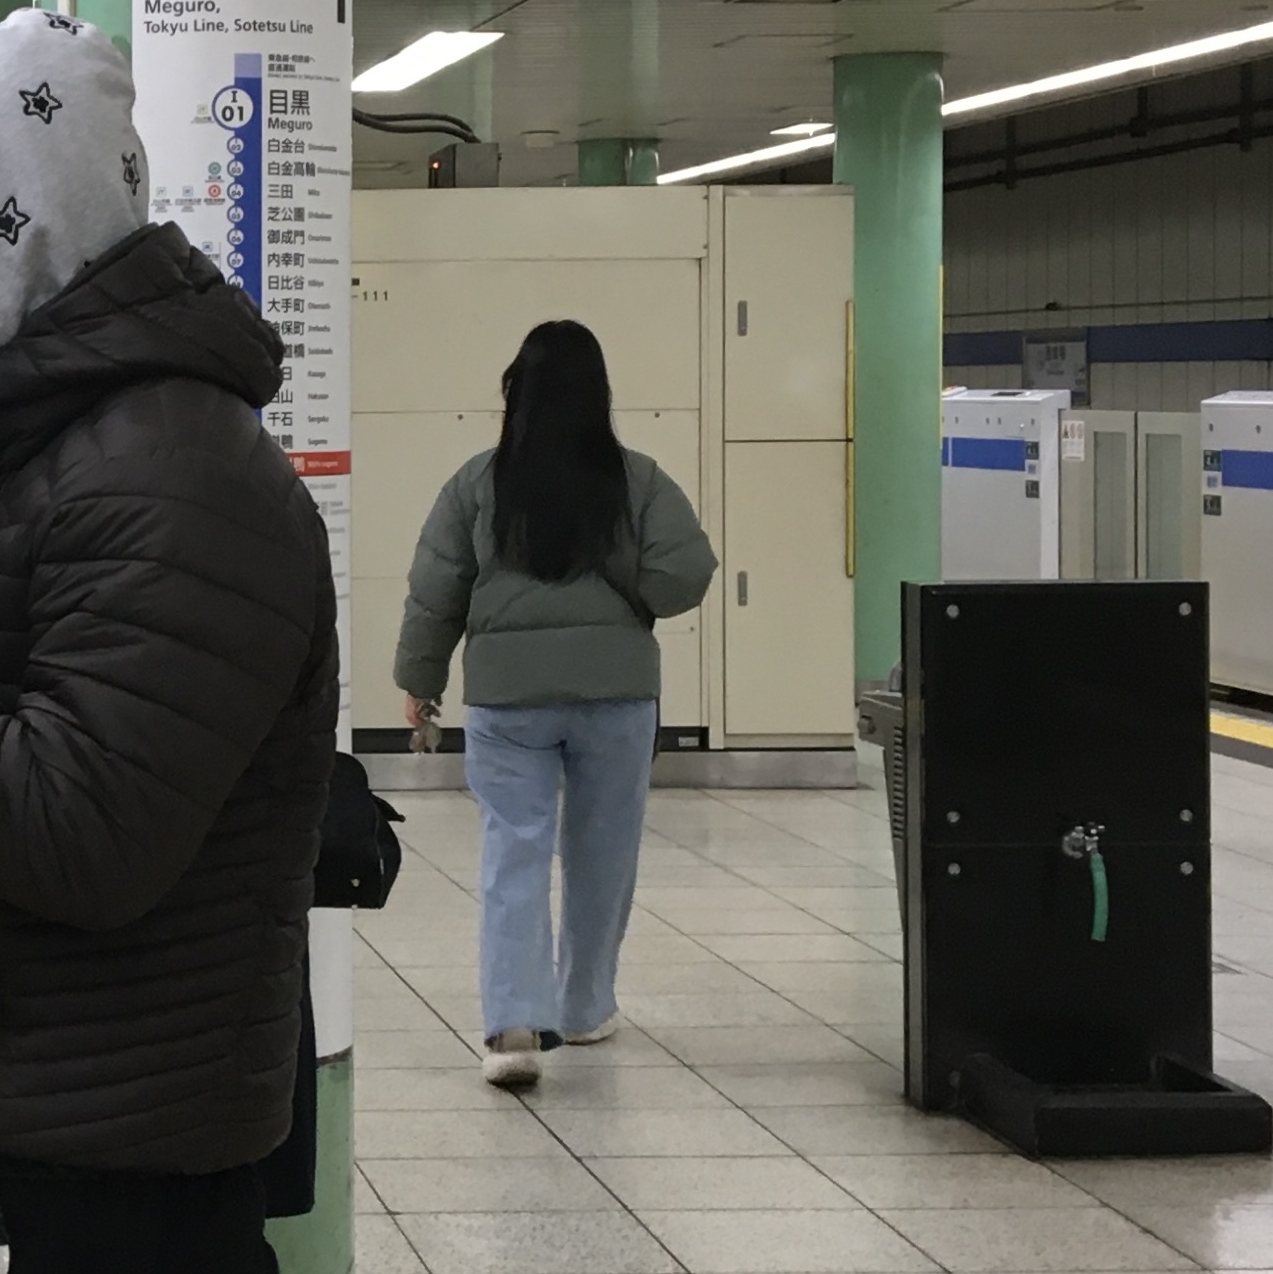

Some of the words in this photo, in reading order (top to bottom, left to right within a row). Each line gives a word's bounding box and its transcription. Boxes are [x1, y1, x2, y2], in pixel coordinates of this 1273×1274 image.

[144, 0, 221, 16] Meguro,
[144, 20, 188, 36] Tokyu
[193, 19, 229, 33] Line,
[233, 18, 286, 33] Sotetsu
[290, 19, 314, 34] Line
[231, 91, 238, 103] I
[269, 89, 311, 116] 目黒
[221, 106, 244, 122] 01
[267, 118, 313, 132] Meguro
[267, 138, 305, 154] 白金台
[267, 184, 293, 199] 三田
[267, 207, 305, 222] 芝公園
[267, 230, 305, 245] 御成門
[267, 252, 305, 268] 内幸町
[267, 275, 305, 290] 日比谷
[267, 298, 305, 313] 大手町
[283, 343, 305, 358] 道橋
[267, 411, 293, 427] 千石
